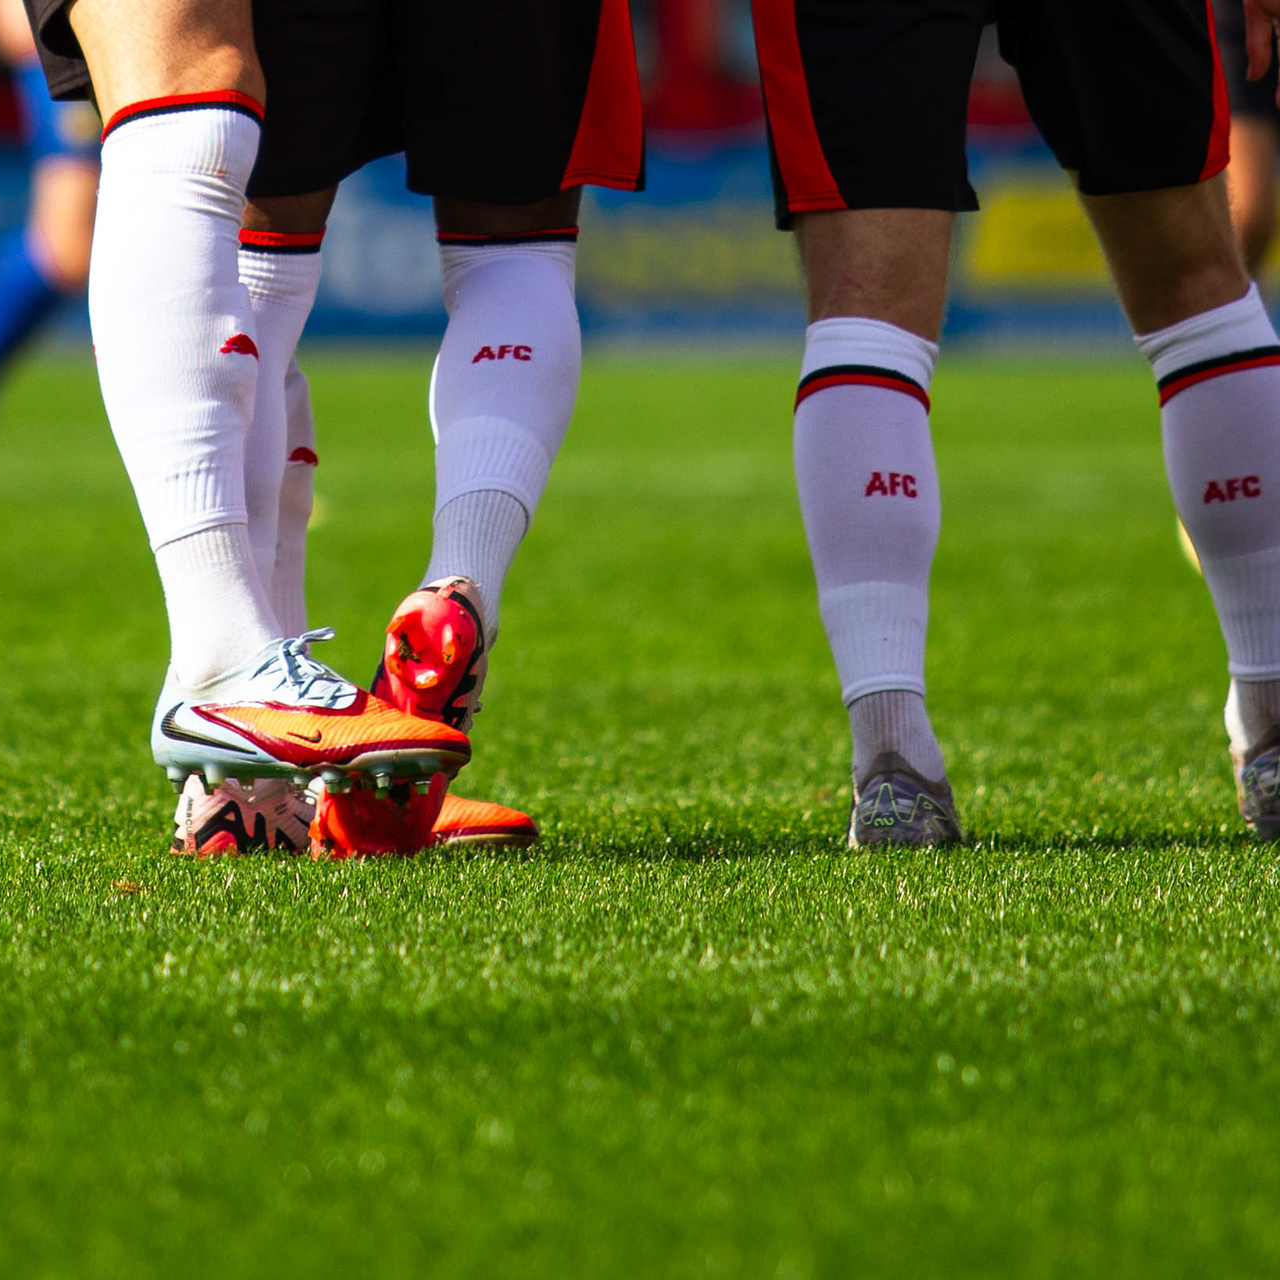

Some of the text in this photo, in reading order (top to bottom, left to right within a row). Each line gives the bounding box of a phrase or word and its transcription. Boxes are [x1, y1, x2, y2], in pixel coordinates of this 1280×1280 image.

[472, 344, 533, 364] AFC
[865, 471, 918, 499] AFC
[1203, 476, 1261, 504] AFC
